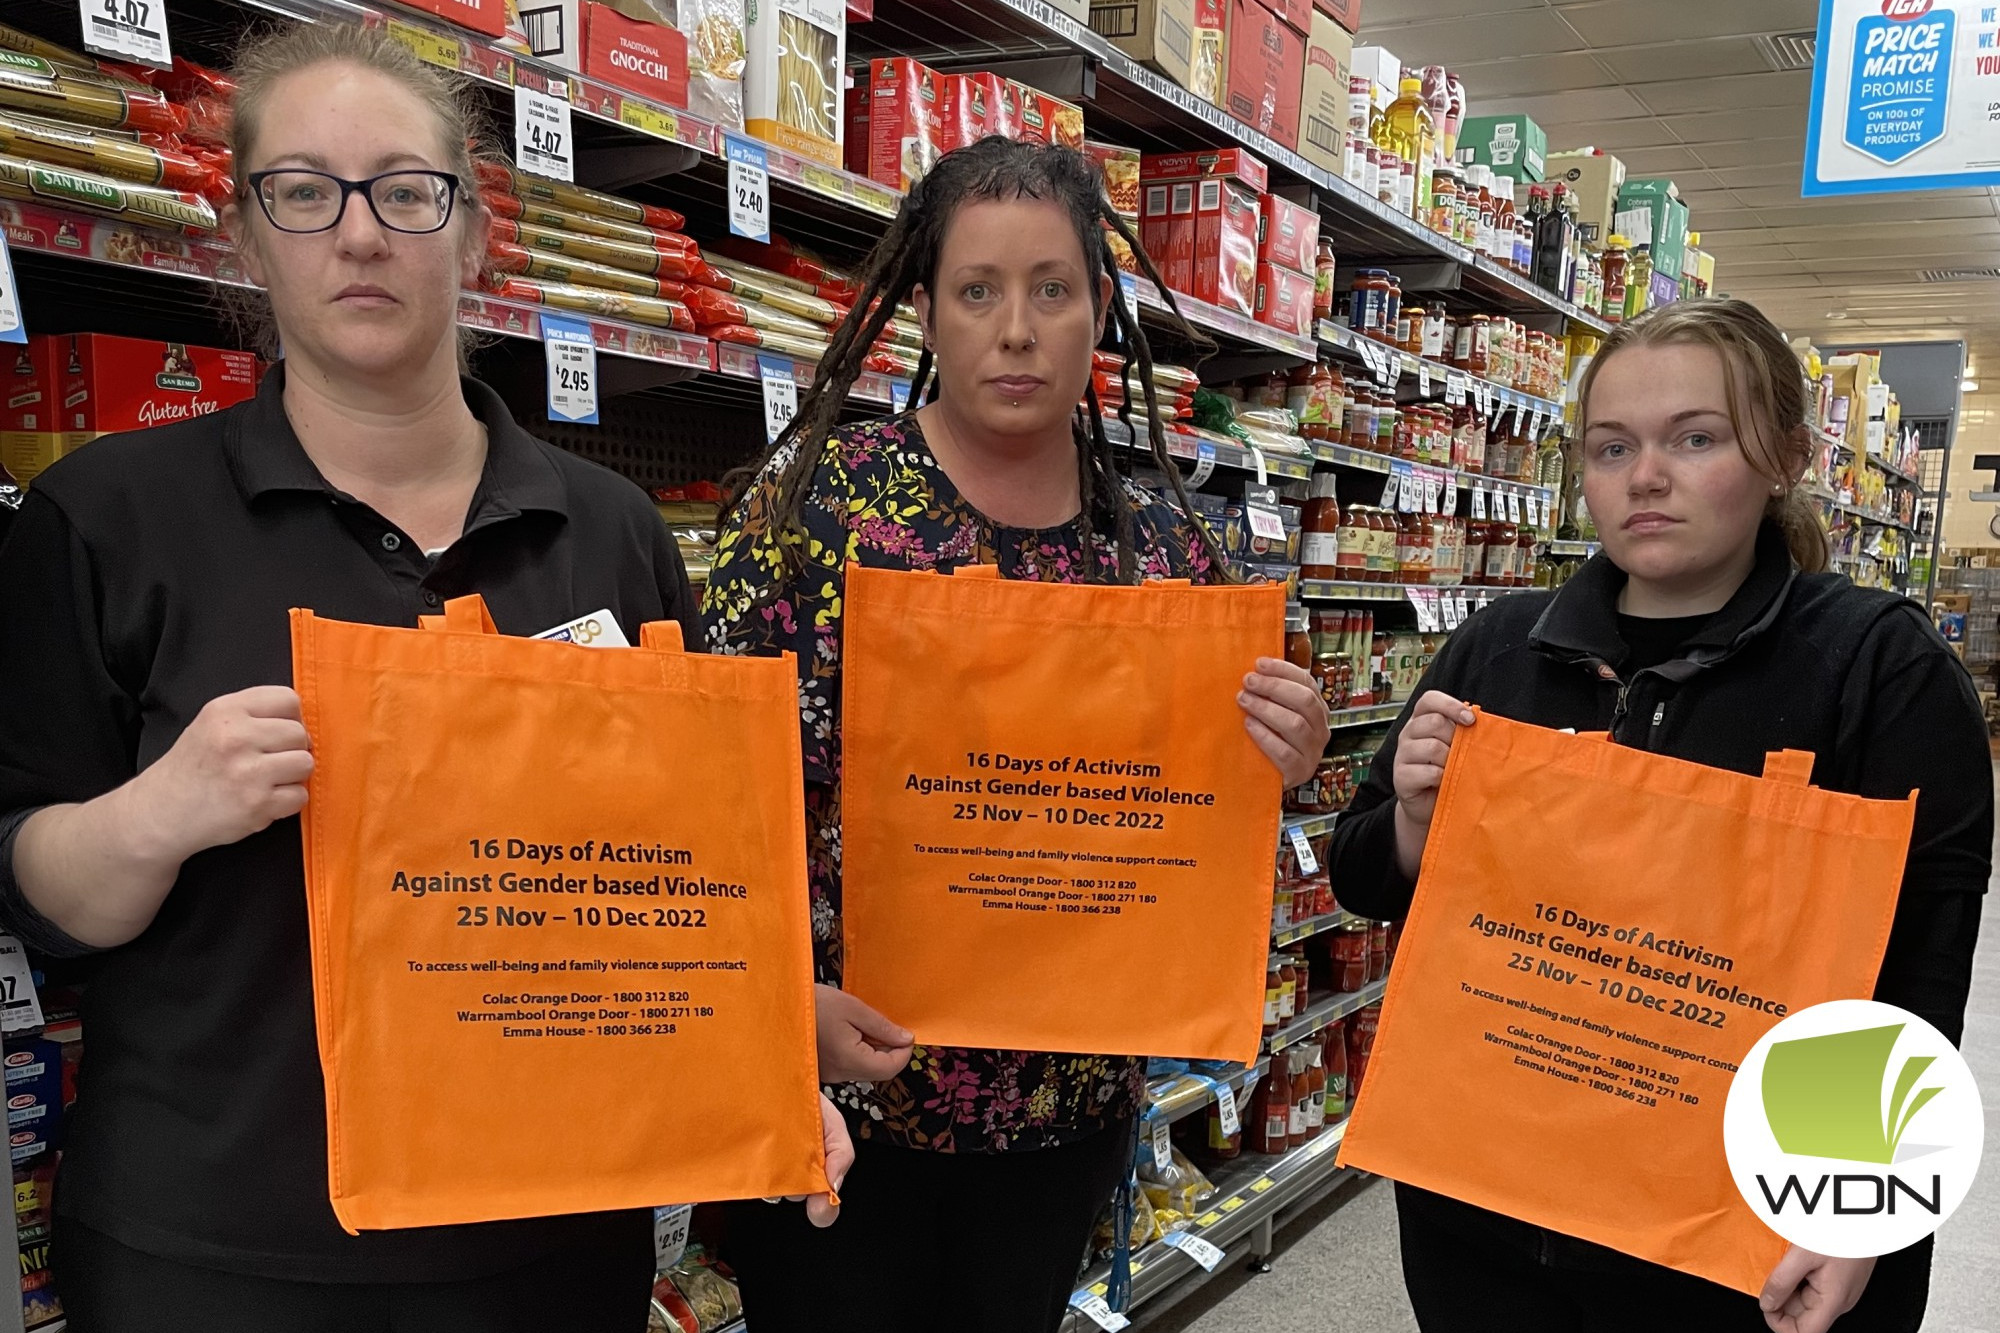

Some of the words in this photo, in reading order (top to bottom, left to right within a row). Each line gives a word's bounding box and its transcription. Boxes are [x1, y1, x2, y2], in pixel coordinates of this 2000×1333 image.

[1981, 8, 1996, 22] WE
[620, 37, 660, 58] TRADITIONAL
[1864, 22, 1944, 54] PRICE
[1978, 33, 1994, 48] WE
[438, 47, 456, 60] 5.69
[1862, 50, 1939, 77] MATCH
[610, 50, 668, 80] GNOCCHI
[1862, 78, 1934, 98] PROMISE
[1868, 111, 1883, 120] ON
[1911, 108, 1925, 116] OF
[1866, 120, 1923, 134] EVERYDAY
[1864, 134, 1921, 146] PRODUCTS
[43, 172, 72, 188] SAN
[74, 178, 113, 198] REMO
[153, 255, 178, 272] Family
[179, 260, 200, 273] Meals
[162, 376, 176, 386] SAN
[176, 379, 196, 388] REMO
[138, 400, 188, 426] Gluten
[190, 396, 220, 416] free
[570, 619, 602, 644] 150
[967, 752, 990, 768] 16
[995, 754, 1044, 775] Days
[1048, 756, 1071, 772] of
[1073, 758, 1161, 778] Activism
[905, 774, 982, 795] Against
[986, 778, 1062, 797] Gender
[1066, 781, 1127, 801] based
[1131, 786, 1215, 806] Violence
[953, 803, 977, 820] 25
[983, 804, 1023, 822] Nov
[1044, 808, 1068, 824] 10
[1072, 808, 1110, 826] Dec
[1114, 811, 1164, 830] 2022
[469, 839, 500, 859] 16
[507, 838, 564, 866] Days
[569, 840, 594, 862] of
[598, 842, 692, 865] Activism
[914, 844, 926, 852] To
[927, 846, 959, 854] access
[961, 847, 1014, 859] well-being
[1016, 849, 1035, 858] and
[1037, 849, 1070, 862] family
[1071, 852, 1114, 863] violence
[1115, 856, 1156, 866] support
[391, 871, 492, 898] Against
[498, 872, 588, 894] Gender
[593, 874, 660, 896] based
[664, 876, 747, 899] Violence
[968, 873, 996, 882] Colac
[998, 874, 1035, 886] Orange
[1037, 876, 1062, 886] Door
[1070, 879, 1096, 888] 1800
[1097, 880, 1116, 889] 312
[1118, 880, 1136, 890] 820
[948, 884, 1016, 896] Warrnambool
[1018, 888, 1056, 900] Orange
[1058, 890, 1083, 900] Door
[1092, 893, 1116, 902] 1800
[1118, 894, 1135, 902] 271
[1139, 894, 1157, 904] 180
[457, 906, 488, 926] 25
[496, 906, 547, 926] Nov
[573, 907, 601, 926] 10
[606, 907, 649, 927] Dec
[654, 908, 707, 928] 2022
[982, 899, 1013, 909] Emma
[1015, 901, 1047, 912] House
[1056, 904, 1080, 913] 1800
[1081, 905, 1100, 914] 366
[1102, 906, 1121, 914] 238
[1535, 903, 1558, 922] 16
[1561, 910, 1610, 938] Days
[1613, 926, 1640, 944] of
[1638, 932, 1734, 972] Activism
[407, 961, 423, 972] To
[426, 963, 468, 972] access
[470, 960, 539, 974] well-being
[542, 960, 567, 971] and
[569, 959, 608, 973] family
[610, 959, 659, 970] violence
[661, 960, 704, 972] support
[1469, 913, 1545, 948] Against
[1548, 936, 1623, 969] Gender
[1626, 955, 1692, 989] based
[1696, 975, 1788, 1018] Violence
[482, 993, 518, 1004] Colac
[520, 993, 568, 1006] Orange
[570, 992, 603, 1003] Door
[613, 992, 642, 1003] 1800
[645, 992, 666, 1002] 312
[668, 991, 689, 1002] 820
[1507, 952, 1534, 972] 25
[1536, 960, 1578, 985] Nov
[1599, 978, 1623, 998] 10
[1626, 986, 1667, 1012] Dec
[1670, 999, 1726, 1029] 2022
[457, 1009, 546, 1022] Warrnambool
[548, 1009, 596, 1022] Orange
[598, 1009, 630, 1020] Door
[640, 1008, 668, 1018] 1800
[670, 1007, 690, 1018] 271
[694, 1006, 714, 1017] 180
[1461, 982, 1472, 993] To
[1472, 988, 1504, 1003] access
[1506, 998, 1559, 1021] well-being
[1560, 1014, 1581, 1026] and
[1581, 1018, 1615, 1038] family
[1616, 1031, 1660, 1050] violence
[1661, 1045, 1706, 1064] support
[503, 1026, 543, 1037] Emma
[546, 1026, 586, 1036] House
[596, 1025, 627, 1036] 1800
[629, 1024, 652, 1035] 366
[654, 1024, 676, 1034] 238
[1507, 1025, 1534, 1040] Colac
[1536, 1034, 1573, 1053] Orange
[1574, 1046, 1601, 1061] Door
[1610, 1057, 1636, 1072] 1800
[1636, 1065, 1657, 1079] 312
[1658, 1072, 1680, 1085] 820
[1484, 1032, 1552, 1060] Warrnambool
[1553, 1054, 1592, 1072] Orange
[1593, 1065, 1620, 1081] Door
[1629, 1077, 1654, 1092] 1800
[1655, 1086, 1675, 1098] 271
[1680, 1092, 1699, 1105] 180
[1514, 1055, 1546, 1072] Emma
[1547, 1066, 1580, 1083] House
[1588, 1079, 1614, 1094] 1800
[1614, 1087, 1635, 1100] 366
[1636, 1094, 1657, 1107] 238
